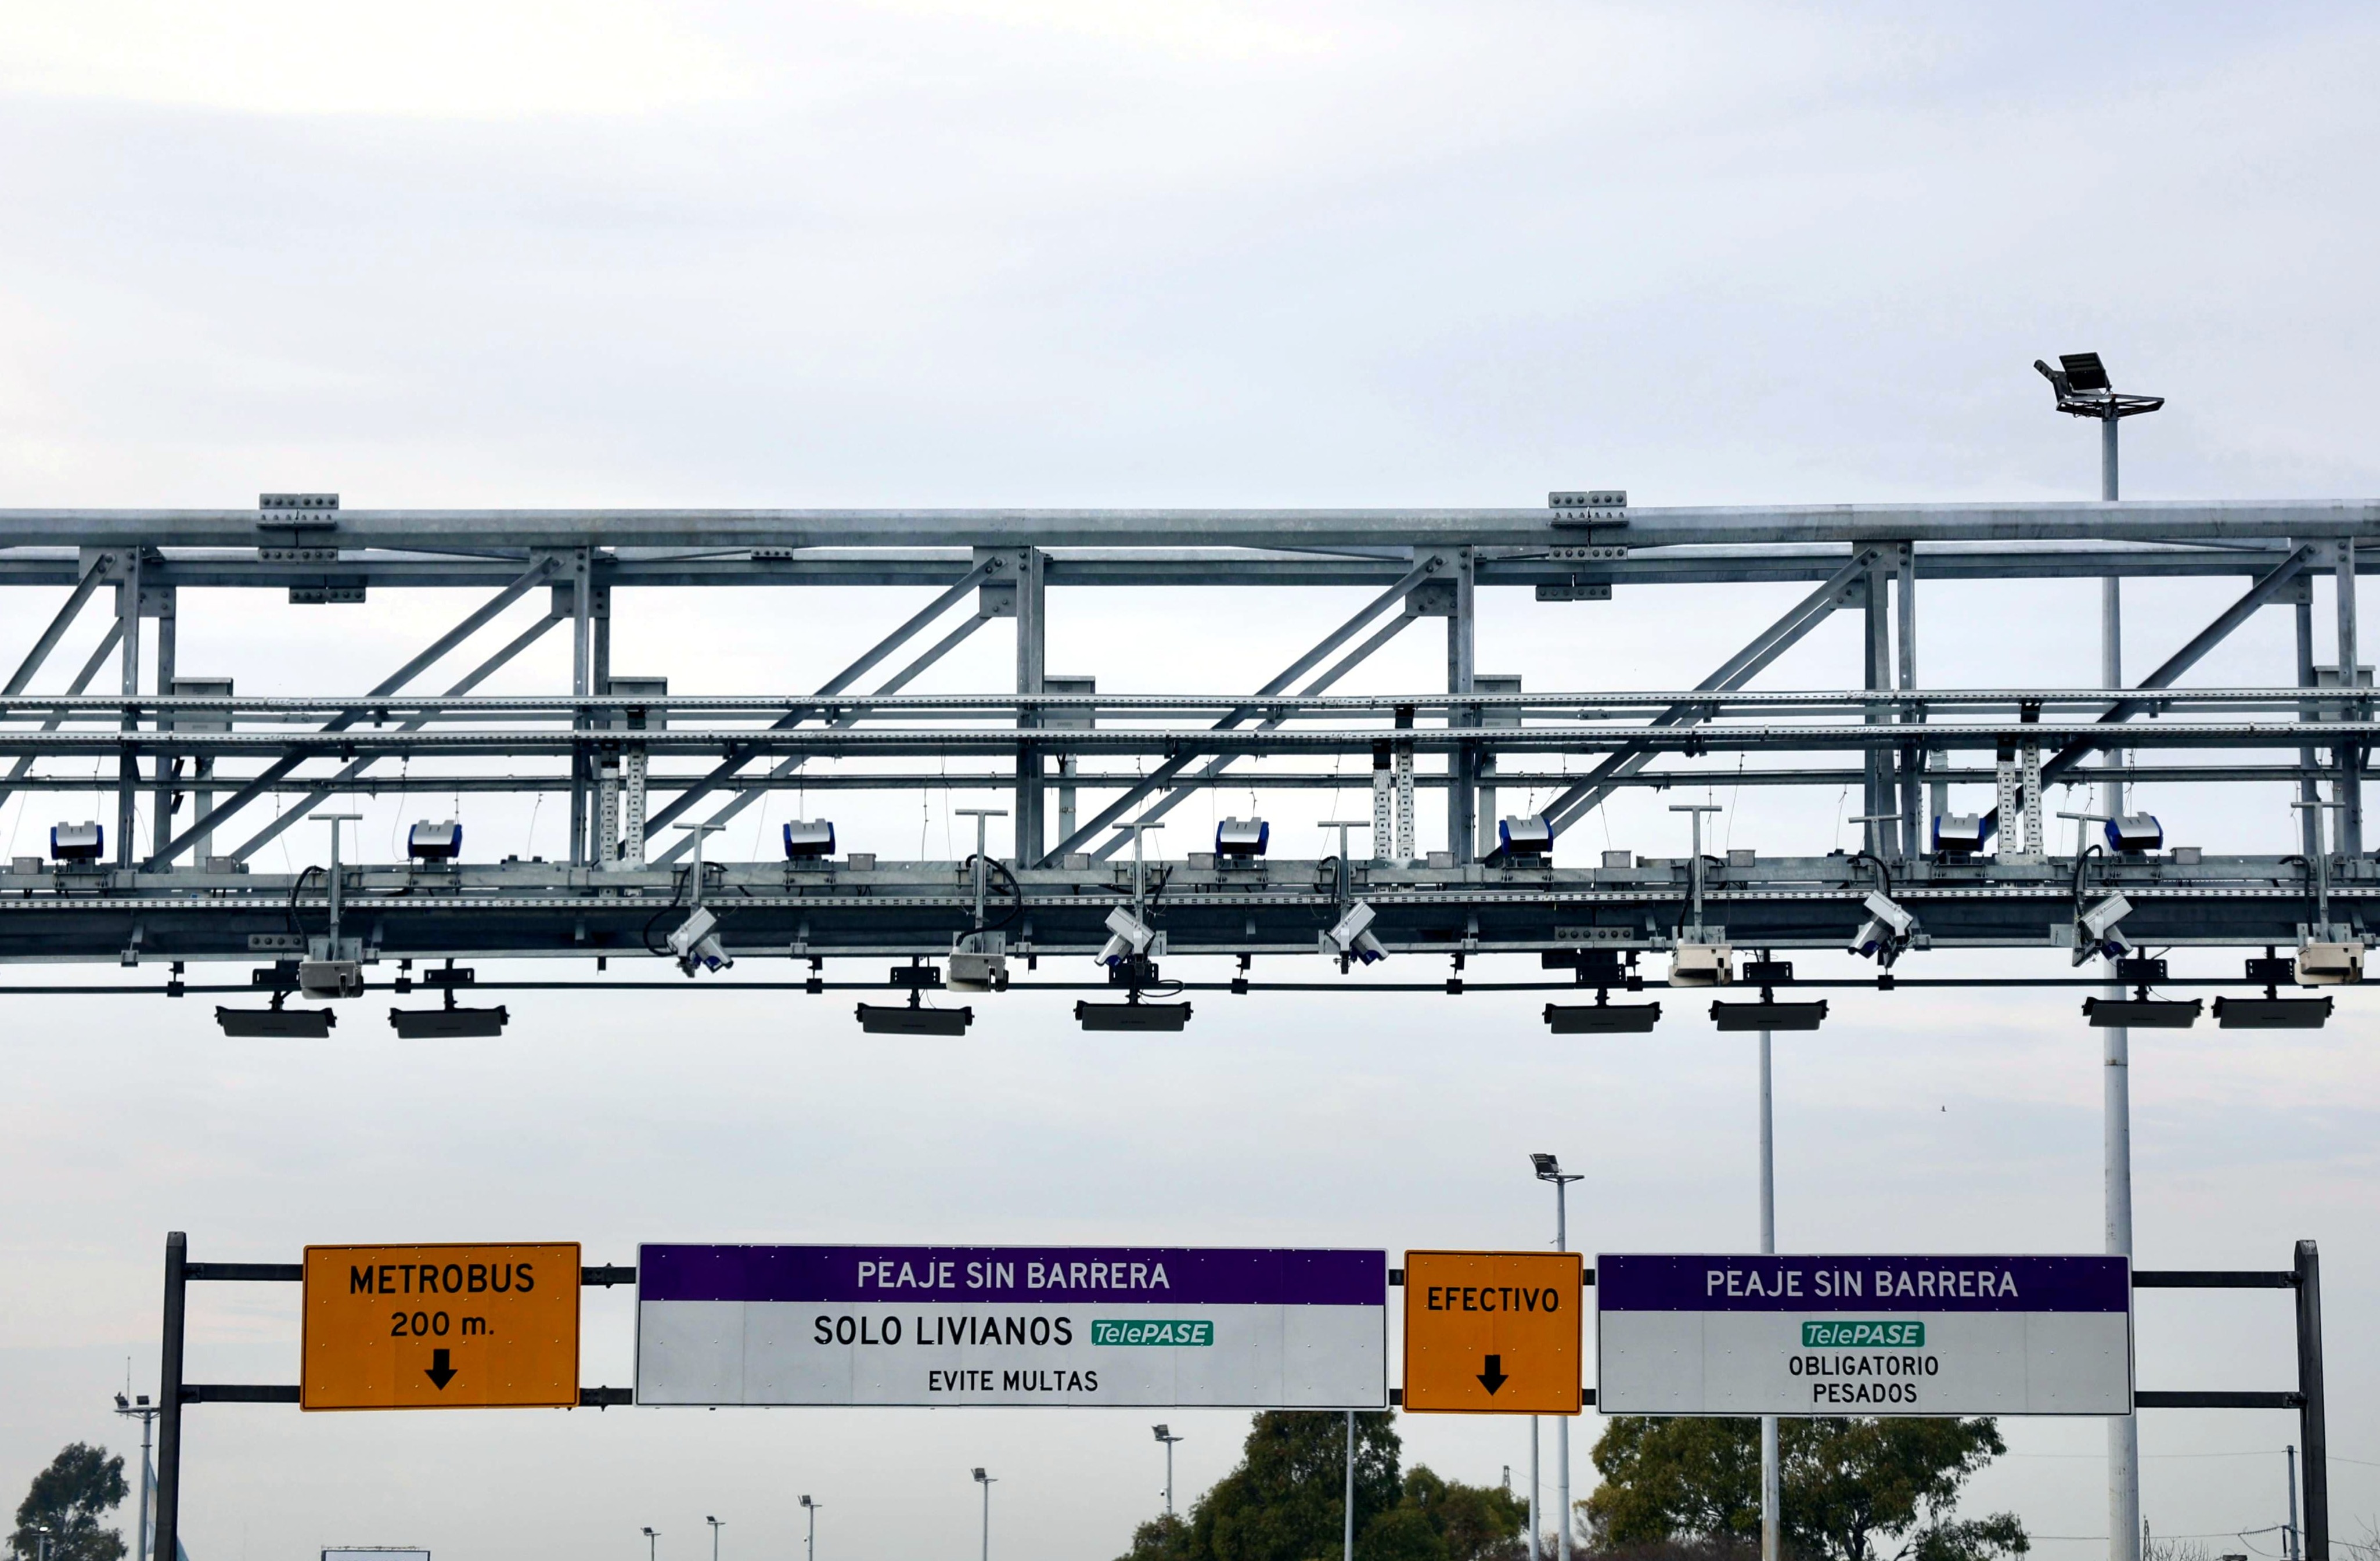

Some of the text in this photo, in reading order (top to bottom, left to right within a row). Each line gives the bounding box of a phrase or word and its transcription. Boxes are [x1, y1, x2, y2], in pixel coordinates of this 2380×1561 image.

[350, 1263, 534, 1295] METROBUS
[858, 1261, 1170, 1289] PEAJE SIN BARRERA
[1707, 1270, 2018, 1297] PEAJE SIN BARRERA
[1428, 1286, 1559, 1313] EFECTIVO
[391, 1311, 495, 1337] 200 m.
[813, 1315, 1209, 1346] SOLO LIVIANOS TelePASE
[1807, 1324, 1920, 1344] TelePASE
[1789, 1355, 1939, 1376] OBLIGATORIO
[929, 1370, 1098, 1391] EVITE MULTAS
[1813, 1383, 1917, 1403] PESADOS
